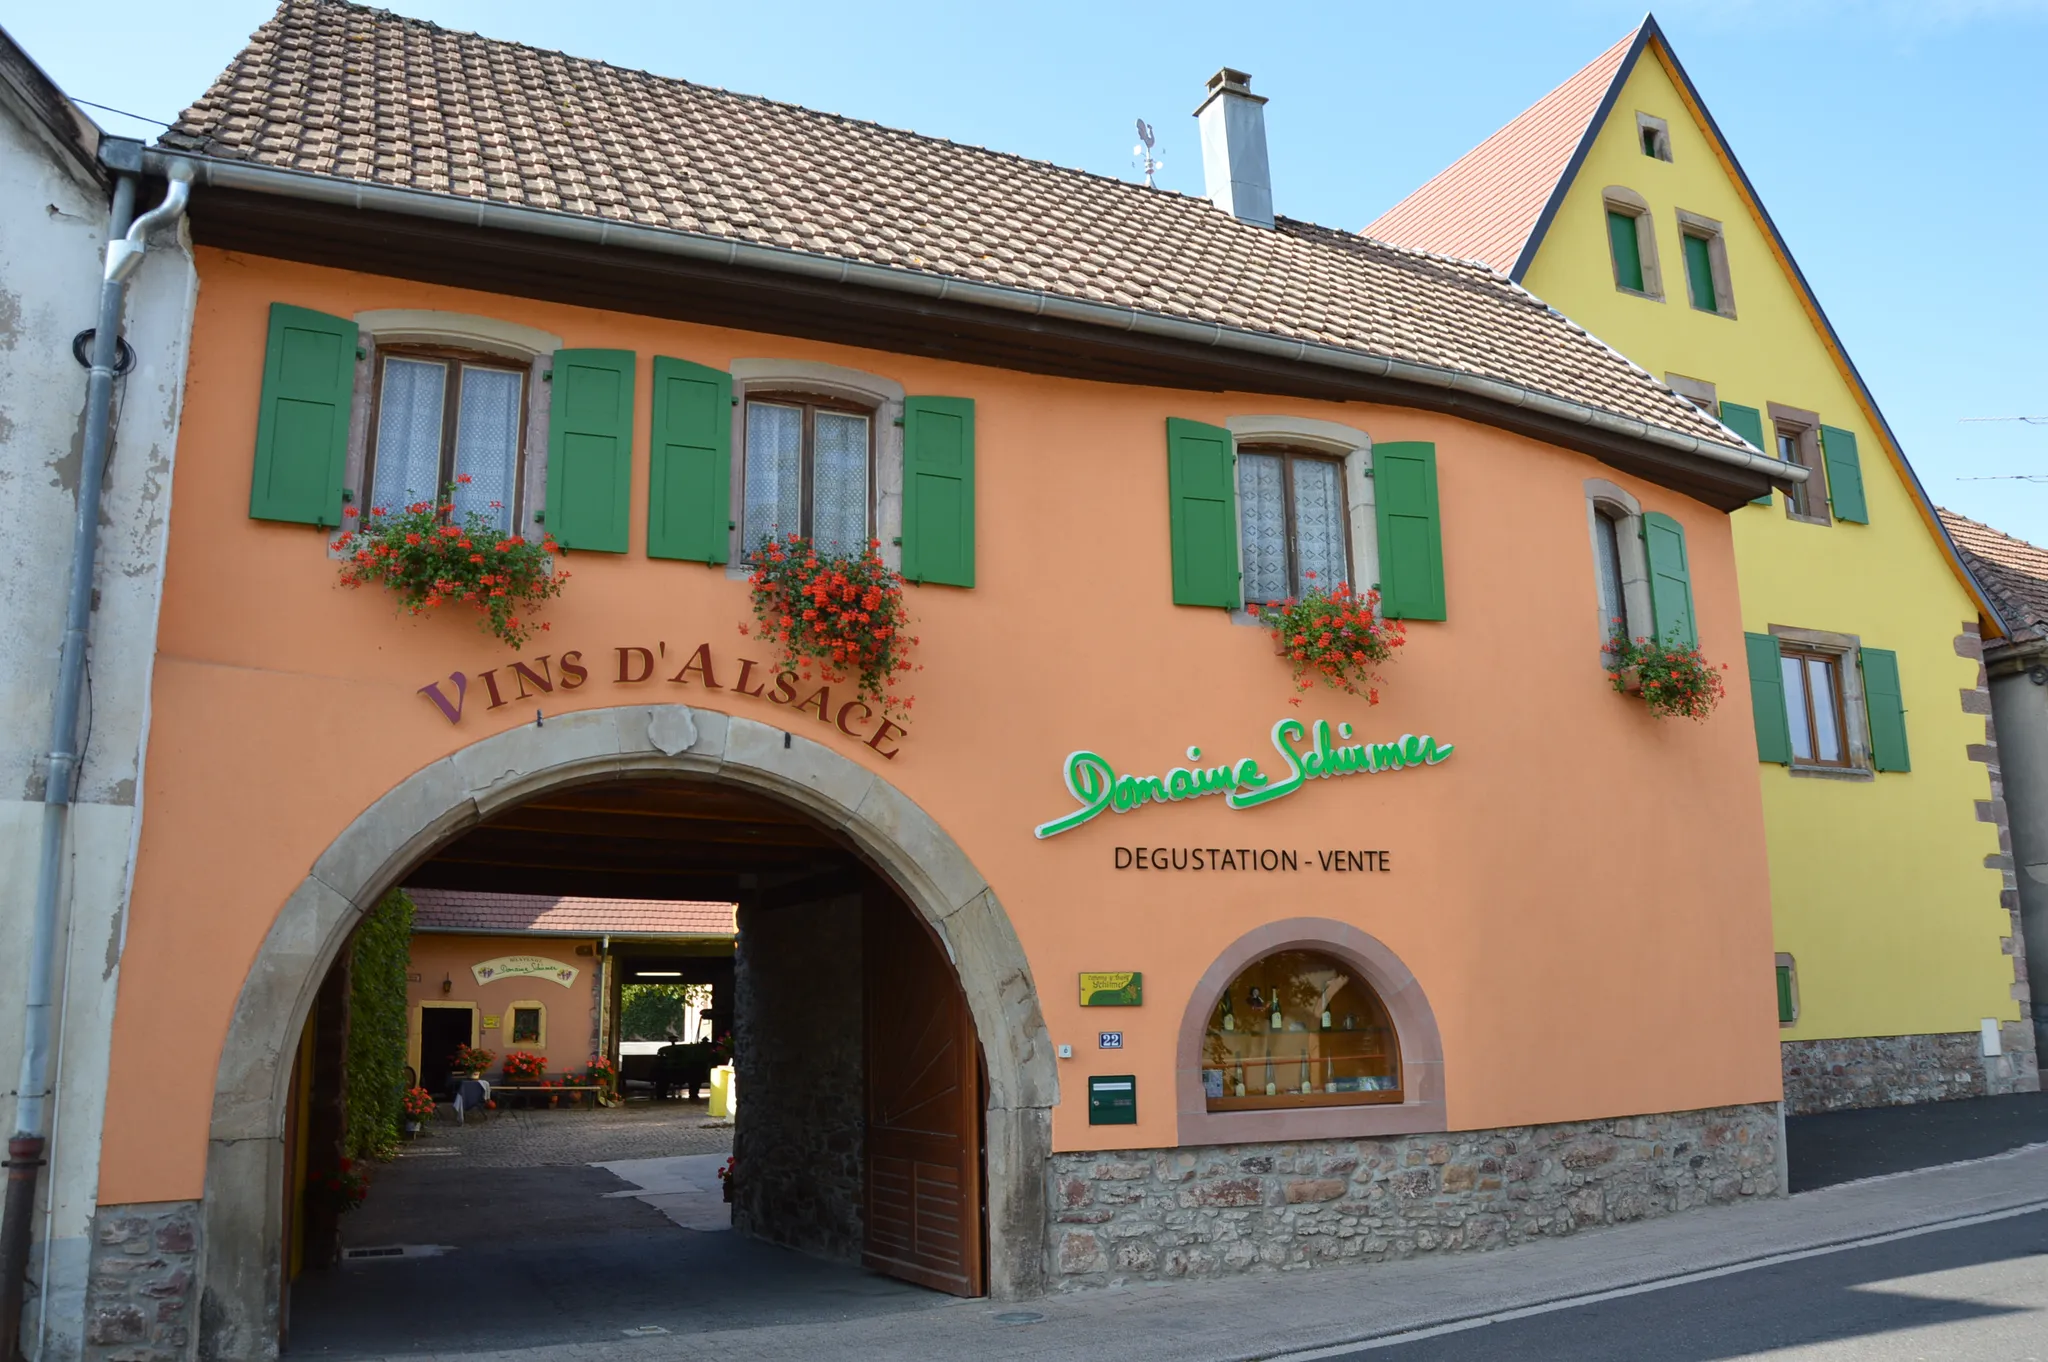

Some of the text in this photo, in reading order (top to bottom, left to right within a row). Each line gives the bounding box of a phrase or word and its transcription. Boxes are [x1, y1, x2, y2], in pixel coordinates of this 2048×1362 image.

[418, 641, 908, 760] VINS D'ALSACE
[1034, 718, 1454, 839] Domaine Schirmer
[1114, 847, 1298, 871] DEGUSTATION
[1318, 850, 1390, 872] VENTE
[1102, 1034, 1119, 1047] 22
